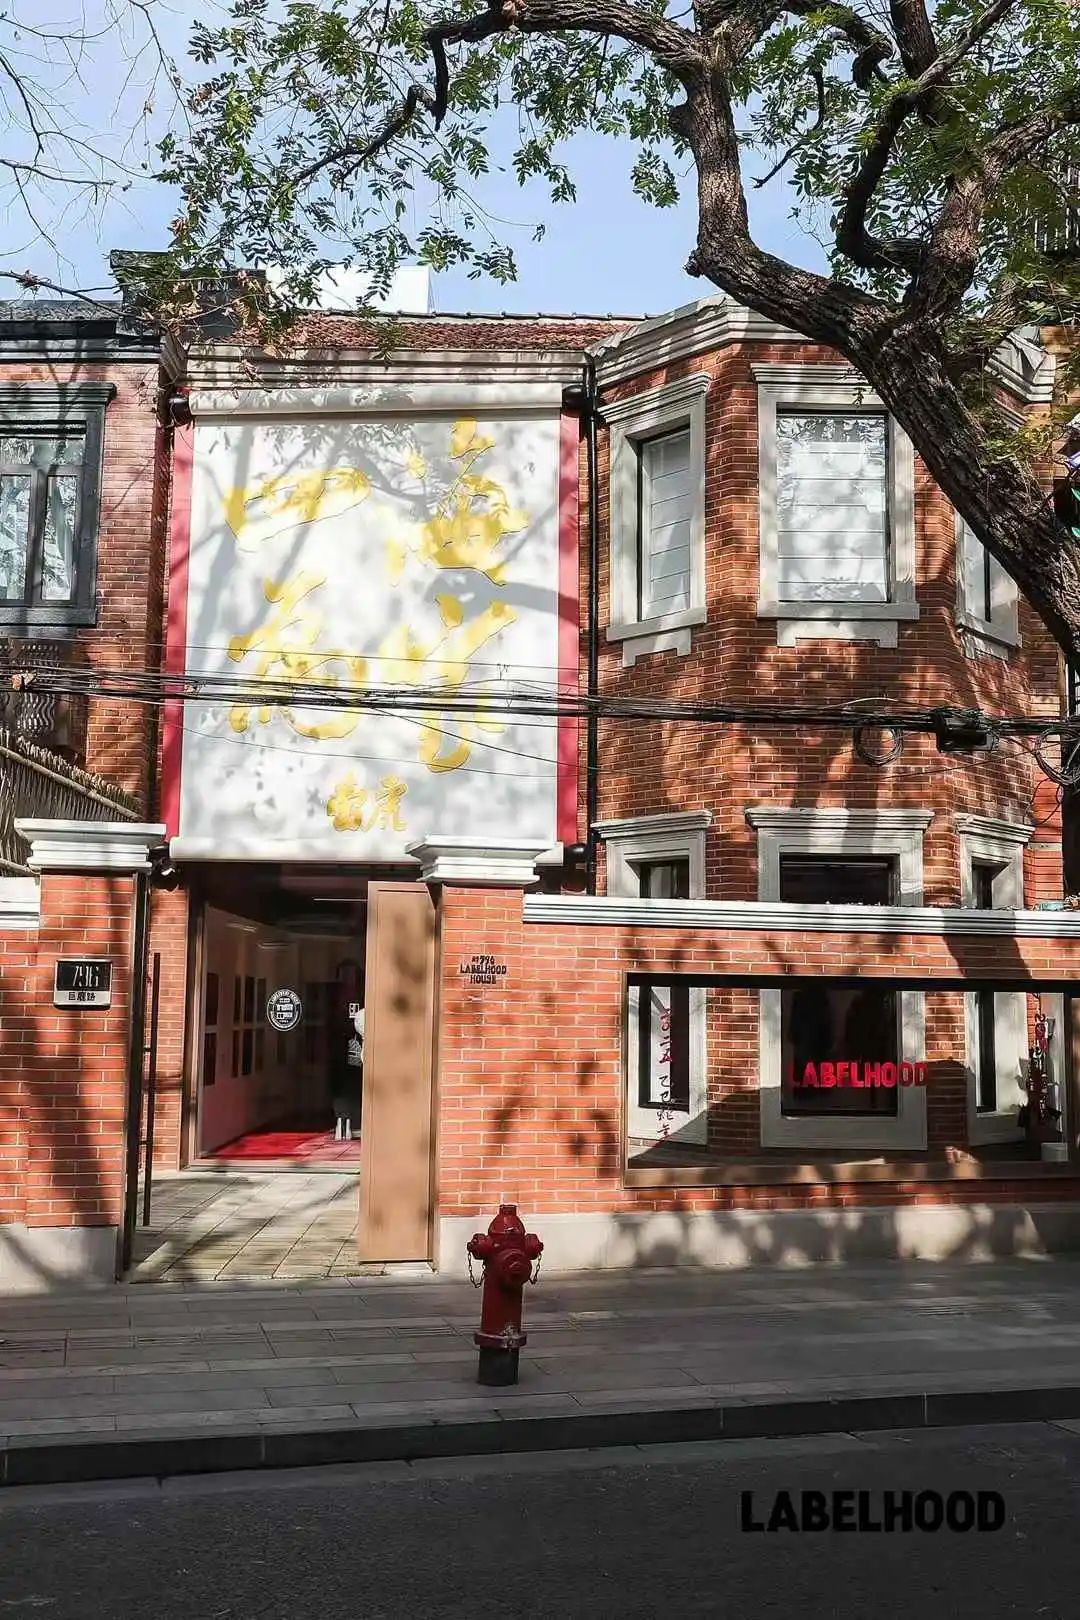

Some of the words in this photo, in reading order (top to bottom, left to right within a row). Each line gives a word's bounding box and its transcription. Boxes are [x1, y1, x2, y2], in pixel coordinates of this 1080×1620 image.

[72, 965, 99, 987] 796
[460, 964, 507, 974] LABELHOOD
[470, 975, 497, 984] HOUSE
[786, 1060, 929, 1088] LABELHOOD
